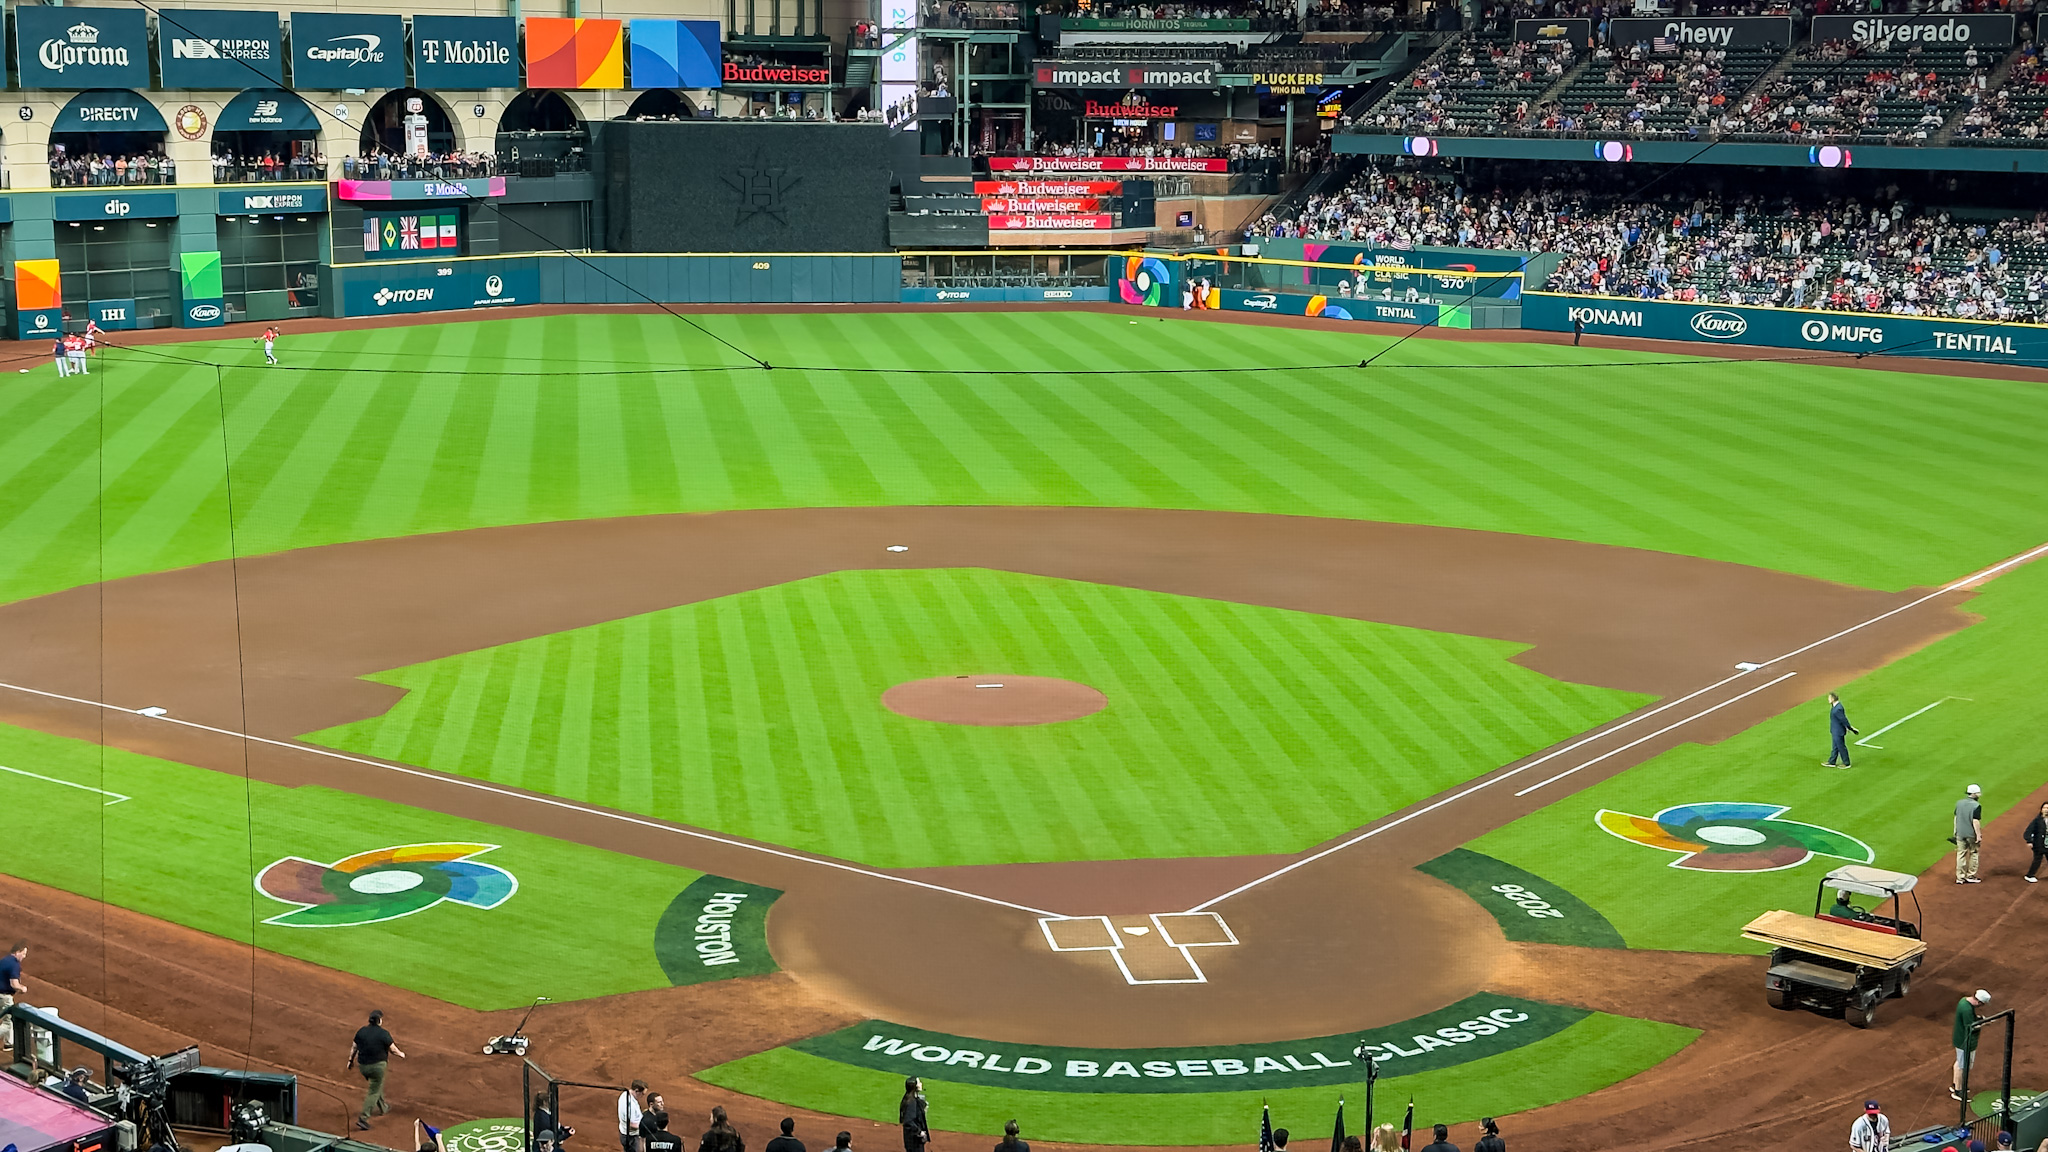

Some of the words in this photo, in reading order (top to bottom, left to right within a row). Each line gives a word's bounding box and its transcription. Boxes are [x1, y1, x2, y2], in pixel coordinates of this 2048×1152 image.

[1125, 19, 1181, 29] HORNITOS
[1851, 18, 1971, 42] Silverado
[1664, 21, 1734, 46] Chevy
[222, 39, 270, 50] NIPPON
[39, 37, 129, 74] Corona
[222, 50, 270, 60] EXPRESS
[422, 39, 439, 64] T
[443, 39, 510, 65] Mobile
[722, 62, 830, 84] Budweiser
[1052, 66, 1121, 87] impact
[1143, 66, 1212, 88] impact
[1252, 73, 1324, 85] PLUCKERS
[1269, 86, 1290, 95] WING
[79, 106, 139, 122] DIRECTV
[335, 107, 347, 116] DK
[1084, 99, 1179, 118] Budweiser
[1032, 157, 1104, 171] Budweiser
[1144, 158, 1208, 172] Budweiser
[424, 182, 434, 196] T
[435, 181, 468, 196] Mobile
[1017, 182, 1090, 195] Budweiser
[273, 194, 303, 202] NIPPON
[1007, 198, 1082, 212] Budweiser
[104, 199, 130, 217] dip
[1024, 215, 1097, 229] Budweiser
[752, 262, 770, 270] 409
[1375, 254, 1405, 265] WORLD
[436, 267, 453, 277] 399
[1440, 278, 1465, 290] 370
[392, 290, 416, 303] ITO
[416, 288, 434, 302] EN
[100, 308, 126, 322] IHI
[191, 306, 219, 319] Kowa
[1375, 306, 1417, 320] TENTIAL
[1568, 306, 1643, 328] KONAMI
[1693, 313, 1744, 333] Kowa
[1831, 324, 1883, 345] MUFG
[1932, 331, 2018, 356] TENTIAL
[1491, 882, 1565, 920] 2026
[693, 891, 749, 968] HOUSTON
[862, 1034, 1053, 1077] WORLD
[1064, 1051, 1352, 1079] BASEBALL
[1353, 1007, 1529, 1063] CLASSIC
